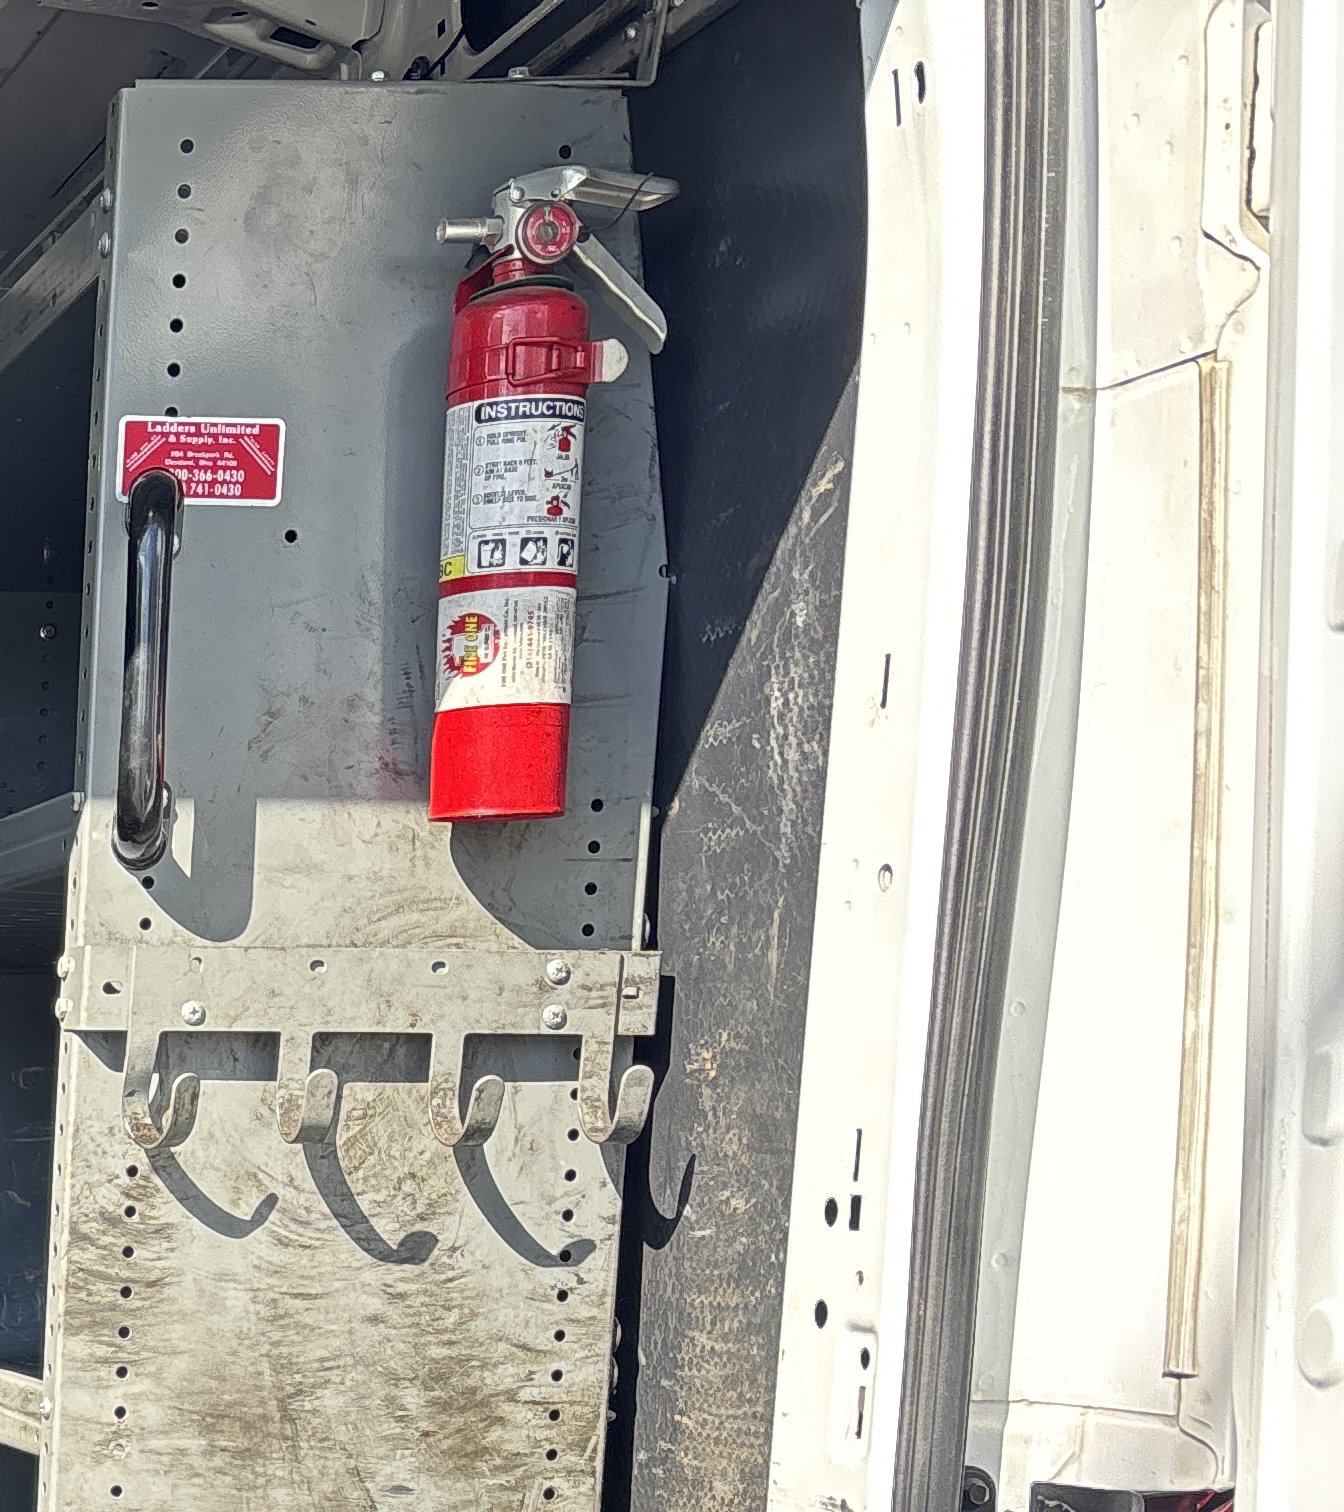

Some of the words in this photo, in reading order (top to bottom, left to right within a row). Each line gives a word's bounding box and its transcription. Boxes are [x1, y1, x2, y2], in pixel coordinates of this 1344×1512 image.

[480, 401, 584, 420] INSTRUCTIONS
[147, 422, 196, 433] Ladders
[200, 423, 260, 435] Unlimited
[218, 436, 237, 444] Inc.
[190, 483, 242, 496] 741-0430
[464, 616, 478, 642] ONE
[462, 645, 478, 673] FIRE
